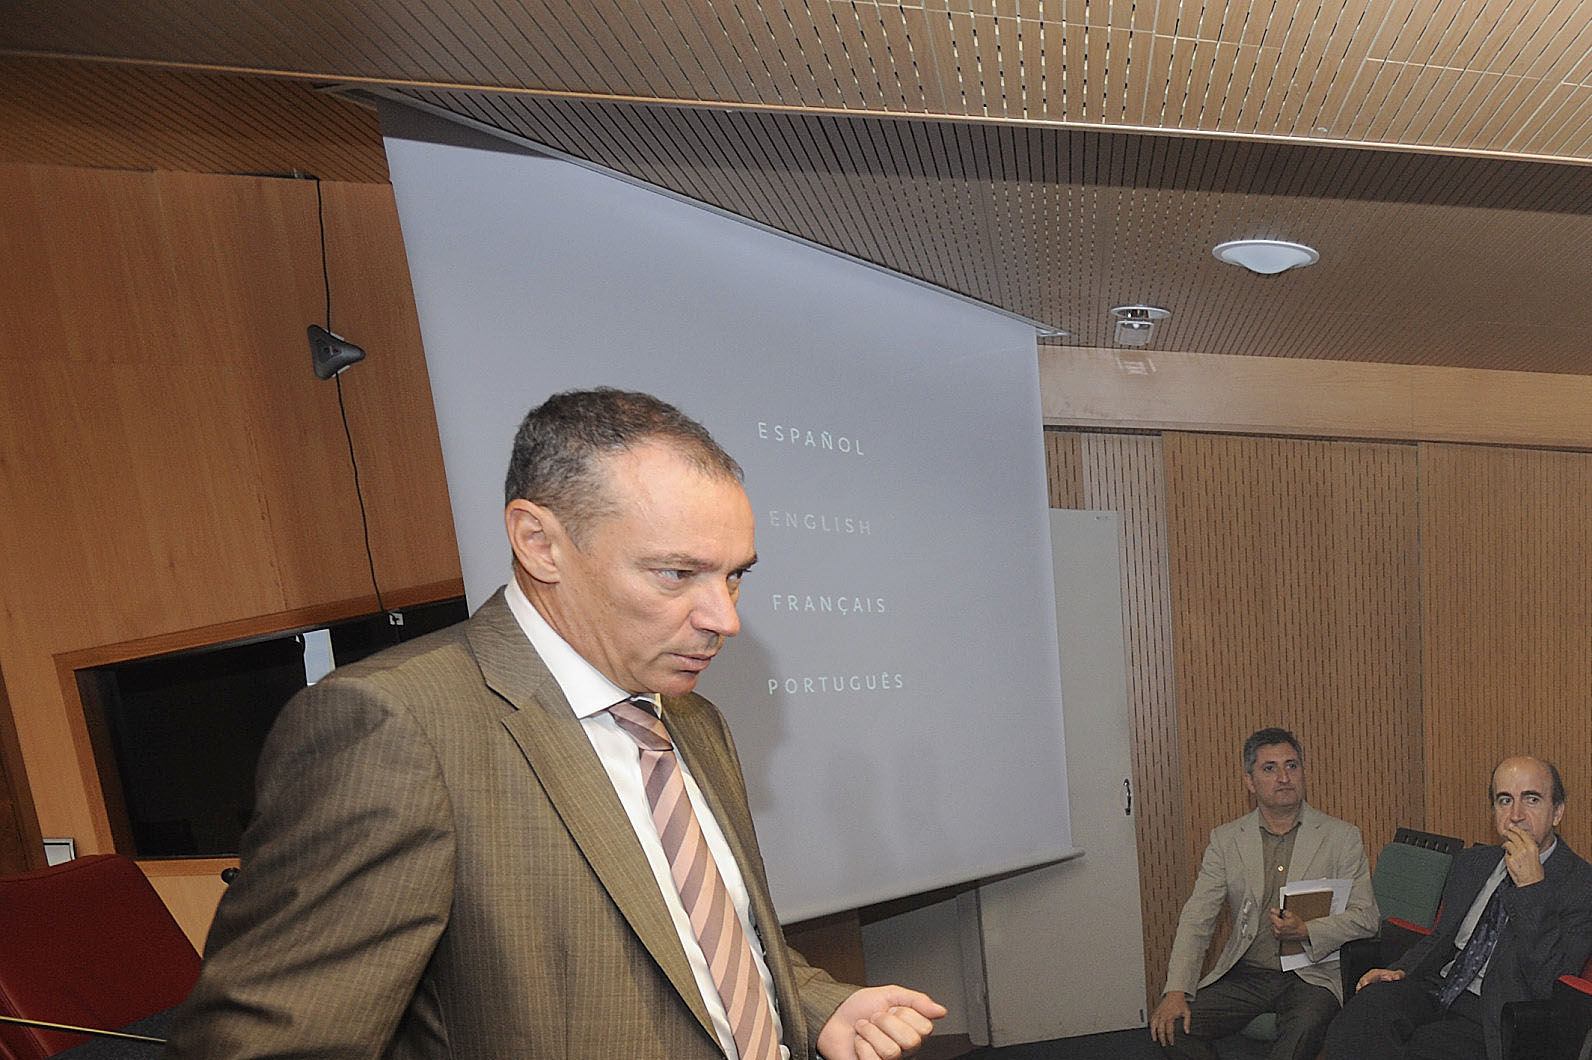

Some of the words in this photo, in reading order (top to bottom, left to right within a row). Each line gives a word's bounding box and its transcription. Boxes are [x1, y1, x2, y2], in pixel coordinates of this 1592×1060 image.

[758, 422, 865, 456] ESPAÑOL
[769, 511, 872, 535] ENGLISH
[772, 595, 886, 615] FRANÇAIS
[768, 672, 904, 695] PORTUGUÊS
